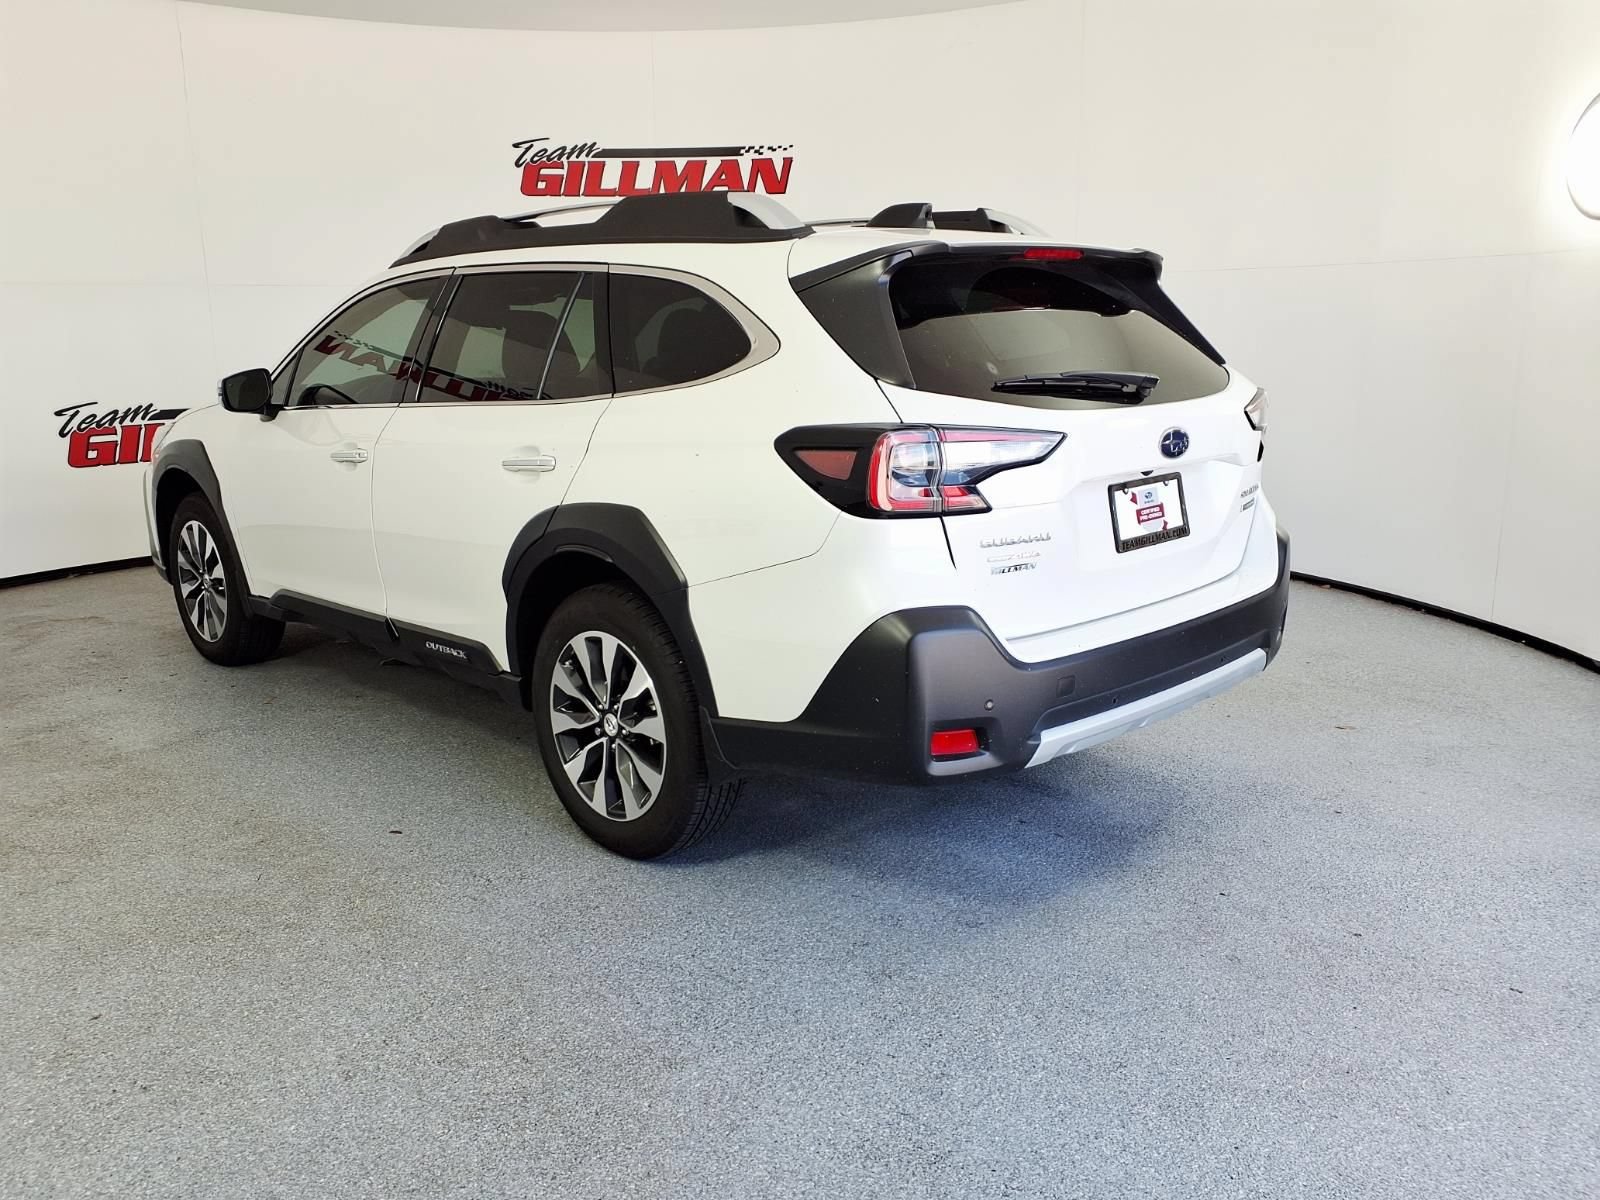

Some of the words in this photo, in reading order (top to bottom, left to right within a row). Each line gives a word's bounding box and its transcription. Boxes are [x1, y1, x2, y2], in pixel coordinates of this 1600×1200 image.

[511, 137, 601, 168] Team
[520, 157, 793, 197] GILLMAN
[54, 402, 157, 438] Team
[425, 641, 467, 659] OUTBACK
